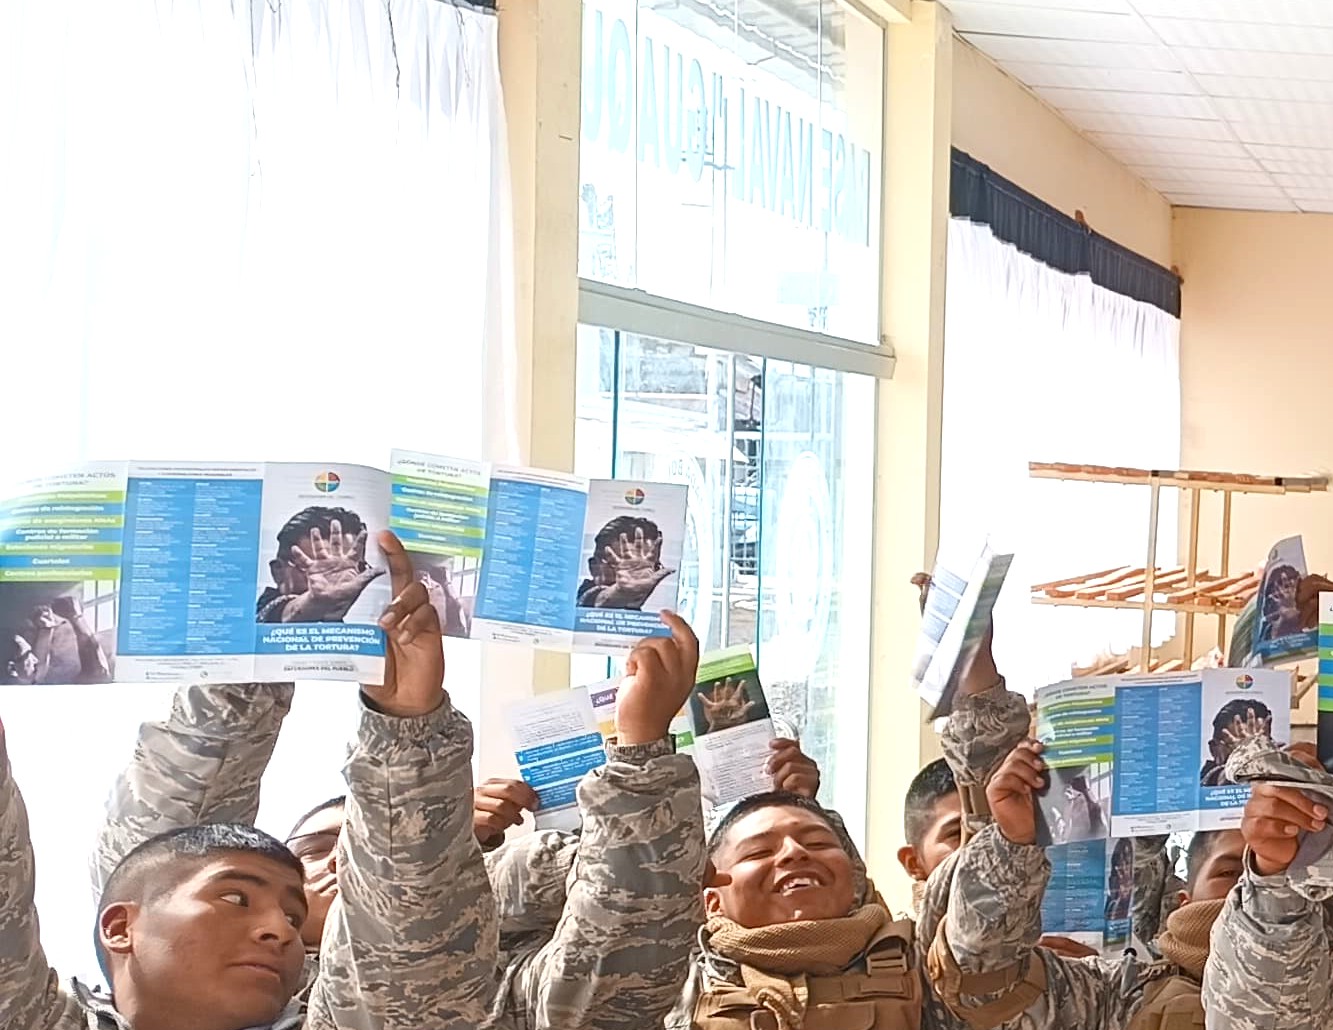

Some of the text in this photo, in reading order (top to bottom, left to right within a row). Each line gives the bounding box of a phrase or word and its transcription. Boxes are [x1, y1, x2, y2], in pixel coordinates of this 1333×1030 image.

[271, 627, 294, 637] ¿QUÉ
[321, 627, 375, 636] MECANISMO
[262, 636, 309, 644] NACIONAL
[314, 643, 360, 651] TORTURA?
